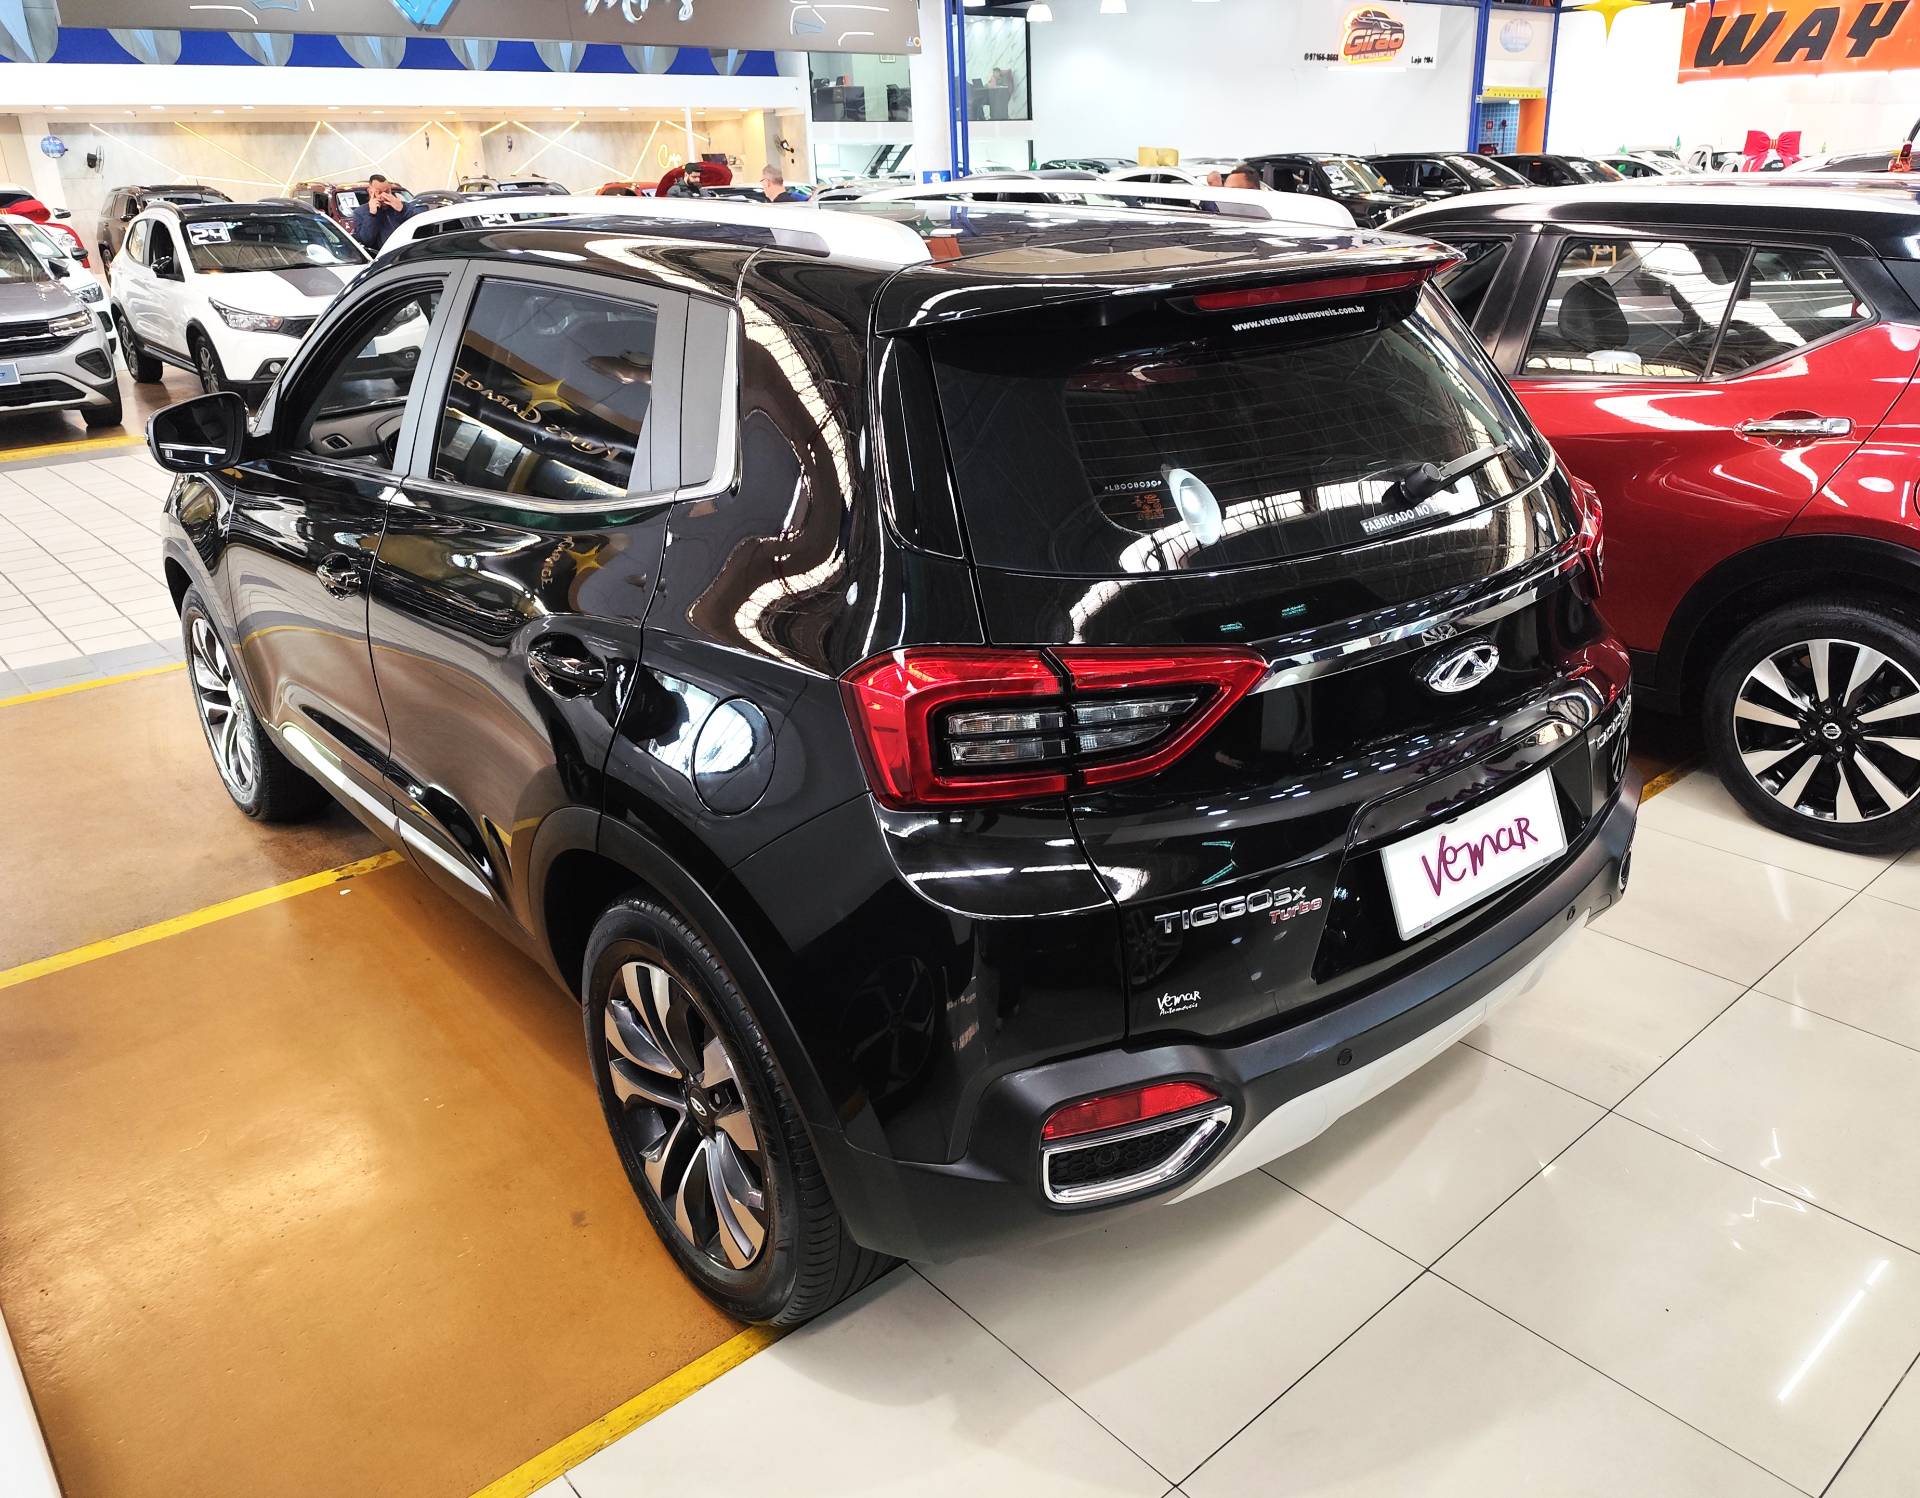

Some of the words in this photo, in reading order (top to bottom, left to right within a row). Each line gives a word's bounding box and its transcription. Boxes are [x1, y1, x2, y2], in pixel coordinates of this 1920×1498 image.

[1694, 0, 1908, 68] WAY
[190, 229, 229, 244] 24
[1232, 305, 1366, 332] www.vemarautomoveis.com.br
[1362, 509, 1415, 533] FABRICADO
[1415, 504, 1430, 518] NO
